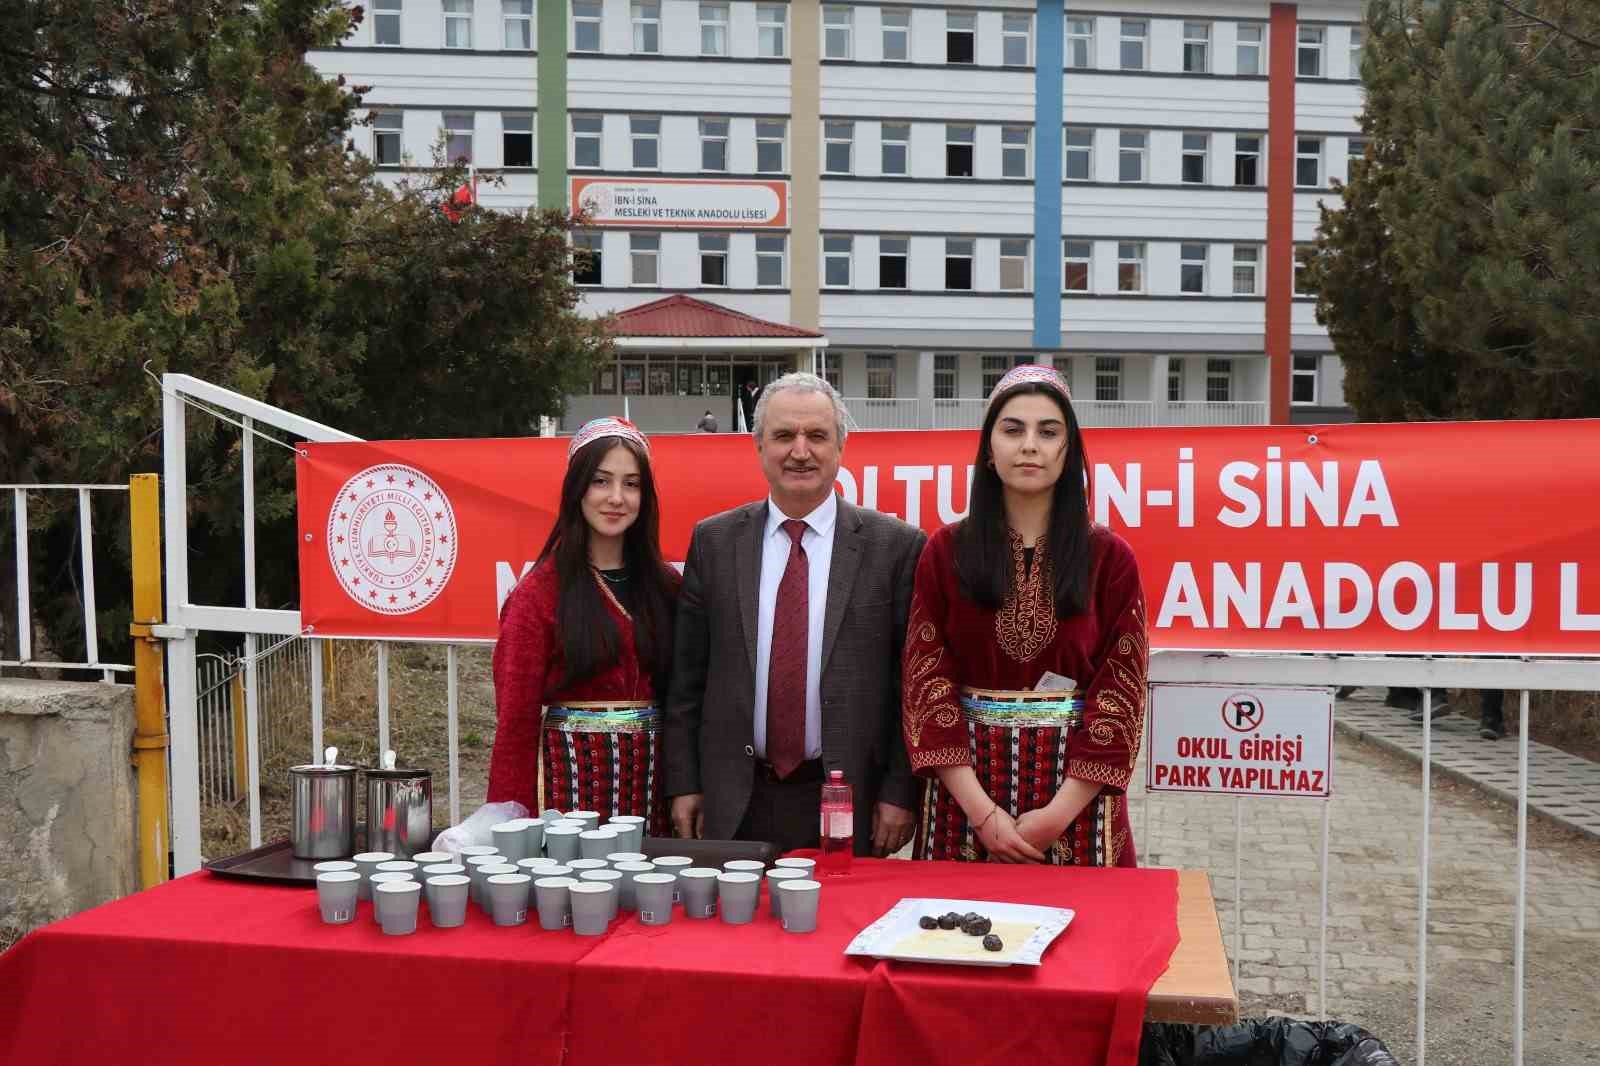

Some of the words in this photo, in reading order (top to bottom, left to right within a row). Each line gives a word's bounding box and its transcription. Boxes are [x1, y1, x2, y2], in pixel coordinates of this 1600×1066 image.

[614, 206, 651, 217] MESLEKİ
[653, 207, 663, 217] VE
[664, 207, 695, 218] TEKNİK
[696, 208, 740, 219] ANADOLU
[742, 208, 768, 220] LİSESİ
[1217, 446, 1399, 528] SİNA
[1156, 561, 1533, 631] ANADOLU
[1177, 736, 1232, 760] OKUL
[1239, 733, 1303, 767] GİRİŞİ
[1155, 765, 1211, 787] PARK
[1218, 766, 1324, 792] YAPILMAZ
